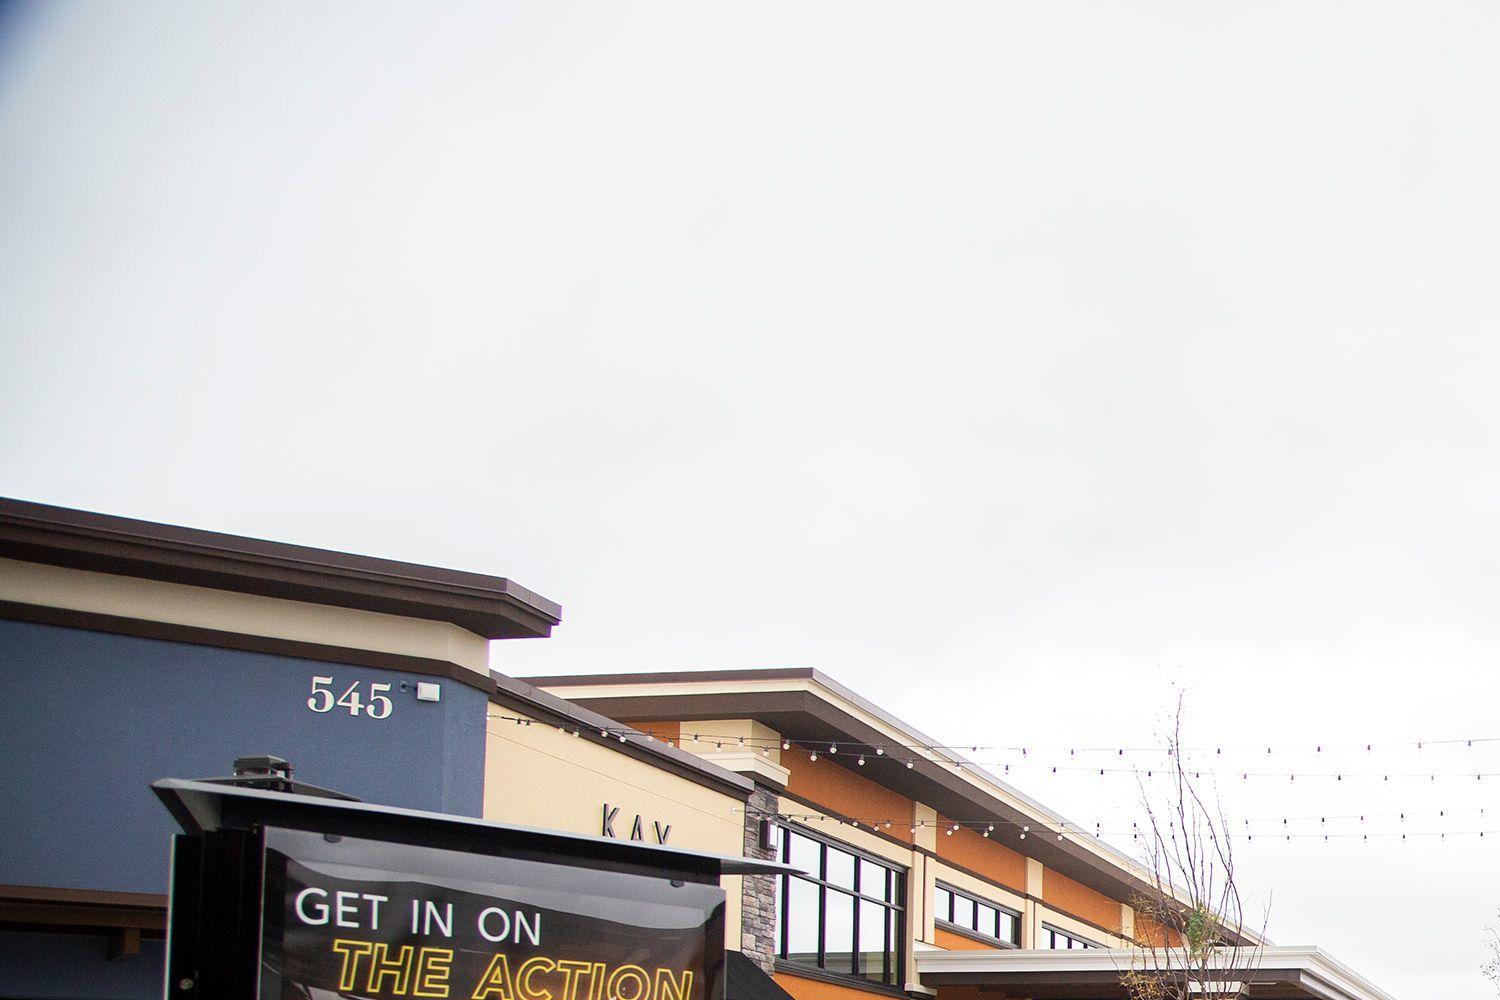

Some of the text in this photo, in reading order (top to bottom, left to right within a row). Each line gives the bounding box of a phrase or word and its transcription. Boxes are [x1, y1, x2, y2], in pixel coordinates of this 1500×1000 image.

[307, 676, 394, 719] 545
[295, 887, 542, 946] GET IN ON
[332, 938, 453, 998] THE
